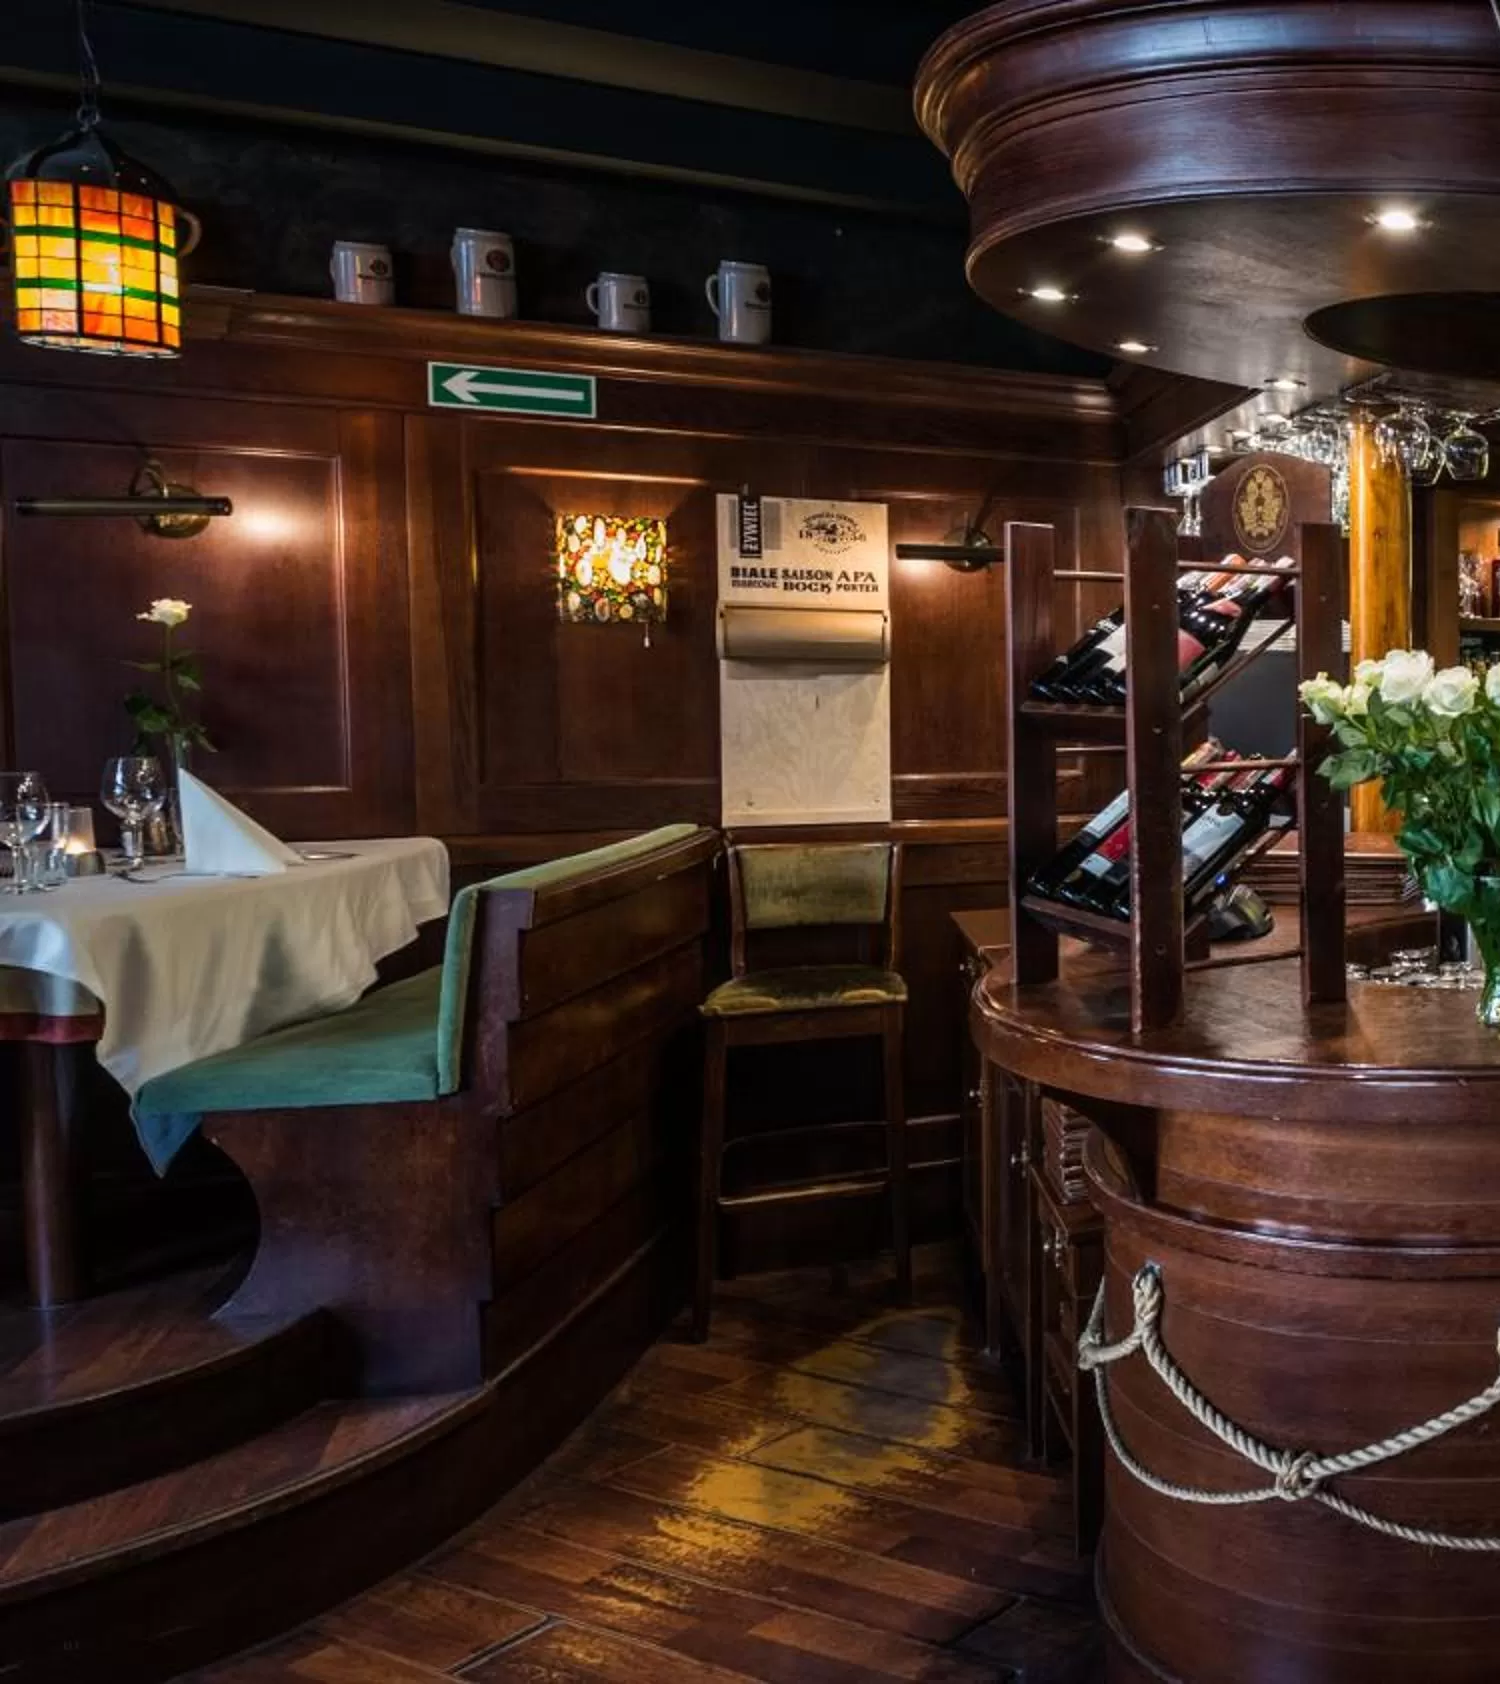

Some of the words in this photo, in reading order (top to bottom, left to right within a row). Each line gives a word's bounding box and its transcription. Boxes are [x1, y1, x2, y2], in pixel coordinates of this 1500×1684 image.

[781, 568, 833, 581] SAISON
[783, 581, 832, 594] BOCK
[835, 583, 879, 593] PORTER
